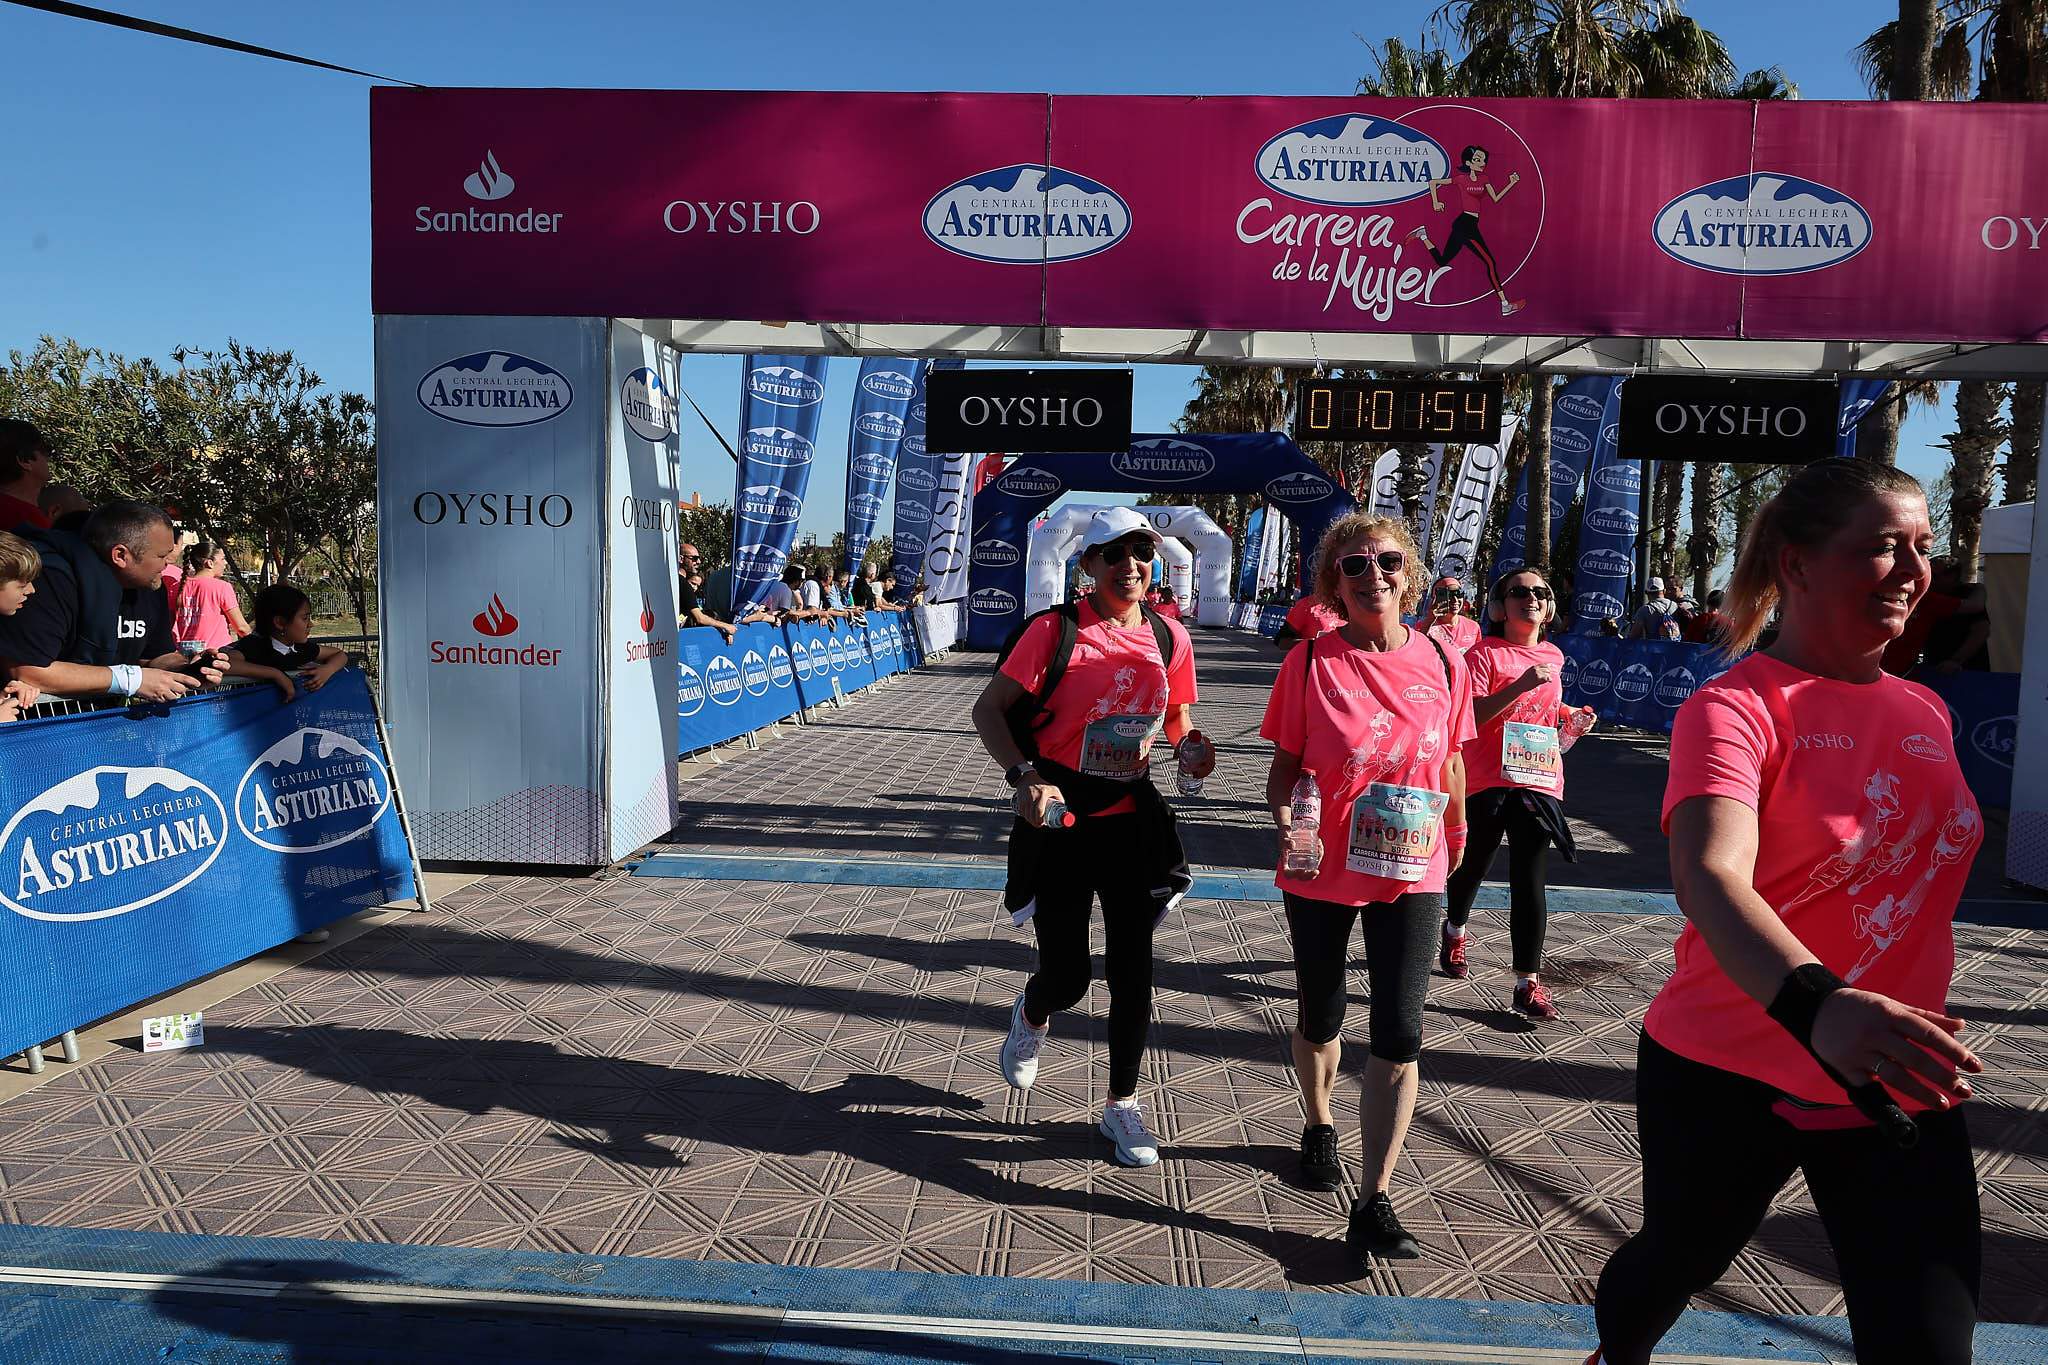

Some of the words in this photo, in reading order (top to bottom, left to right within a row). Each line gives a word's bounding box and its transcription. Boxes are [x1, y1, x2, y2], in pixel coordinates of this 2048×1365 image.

[1301, 145, 1361, 155] CENTRAL
[1367, 146, 1429, 155] LECHERA
[1270, 147, 1433, 183] ASTURIANA
[971, 199, 1036, 208] CENTRAL
[1704, 208, 1771, 218] CENTRAL
[1779, 208, 1849, 218] LECHERA
[415, 206, 563, 233] Santander
[663, 200, 820, 234] OYSHO
[938, 200, 1115, 237] ASTURIANA
[1236, 198, 1393, 249] Carrera
[1669, 209, 1854, 248] ASTURIANA
[1982, 216, 2048, 250] OY
[1272, 249, 1301, 282] de
[1308, 249, 1329, 283] la
[1322, 243, 1453, 322] Mujer
[429, 378, 562, 409] ASTURIANA
[453, 377, 502, 385] CENTRAL
[506, 378, 556, 386] LECHERA
[748, 375, 818, 400] ASTURIANA
[625, 387, 671, 428] ASTURIANA
[959, 396, 1103, 427] OYSHO
[1310, 389, 1487, 431] 01:01:54
[1655, 403, 1807, 437] OYSHO
[1551, 434, 1587, 450] STURIANA
[1118, 454, 1208, 472] ASTURIANA
[899, 473, 935, 488] ASTURIANA
[1001, 478, 1056, 491] ASTURIANA
[1271, 482, 1330, 496] ASTURIANA
[412, 490, 573, 528] OYSHO
[622, 495, 673, 532] OYSHO
[1438, 444, 1500, 581] OYSHO
[973, 548, 1017, 561] ASTURIANA
[971, 596, 1014, 609] ASTURIANA
[430, 641, 562, 667] Santander
[626, 638, 668, 663] Santander
[709, 675, 741, 696] ASTURIANA
[1327, 688, 1369, 699] OYSHO
[272, 771, 323, 788] CENTRAL
[253, 777, 383, 833] ASTURIANA
[50, 811, 127, 843] CENTRAL
[133, 794, 204, 821] LECHERA
[1384, 826, 1420, 845] 016
[17, 814, 217, 900] ASTURIANA
[1353, 848, 1379, 858] CARRERA
[1357, 859, 1390, 872] OYSHO
